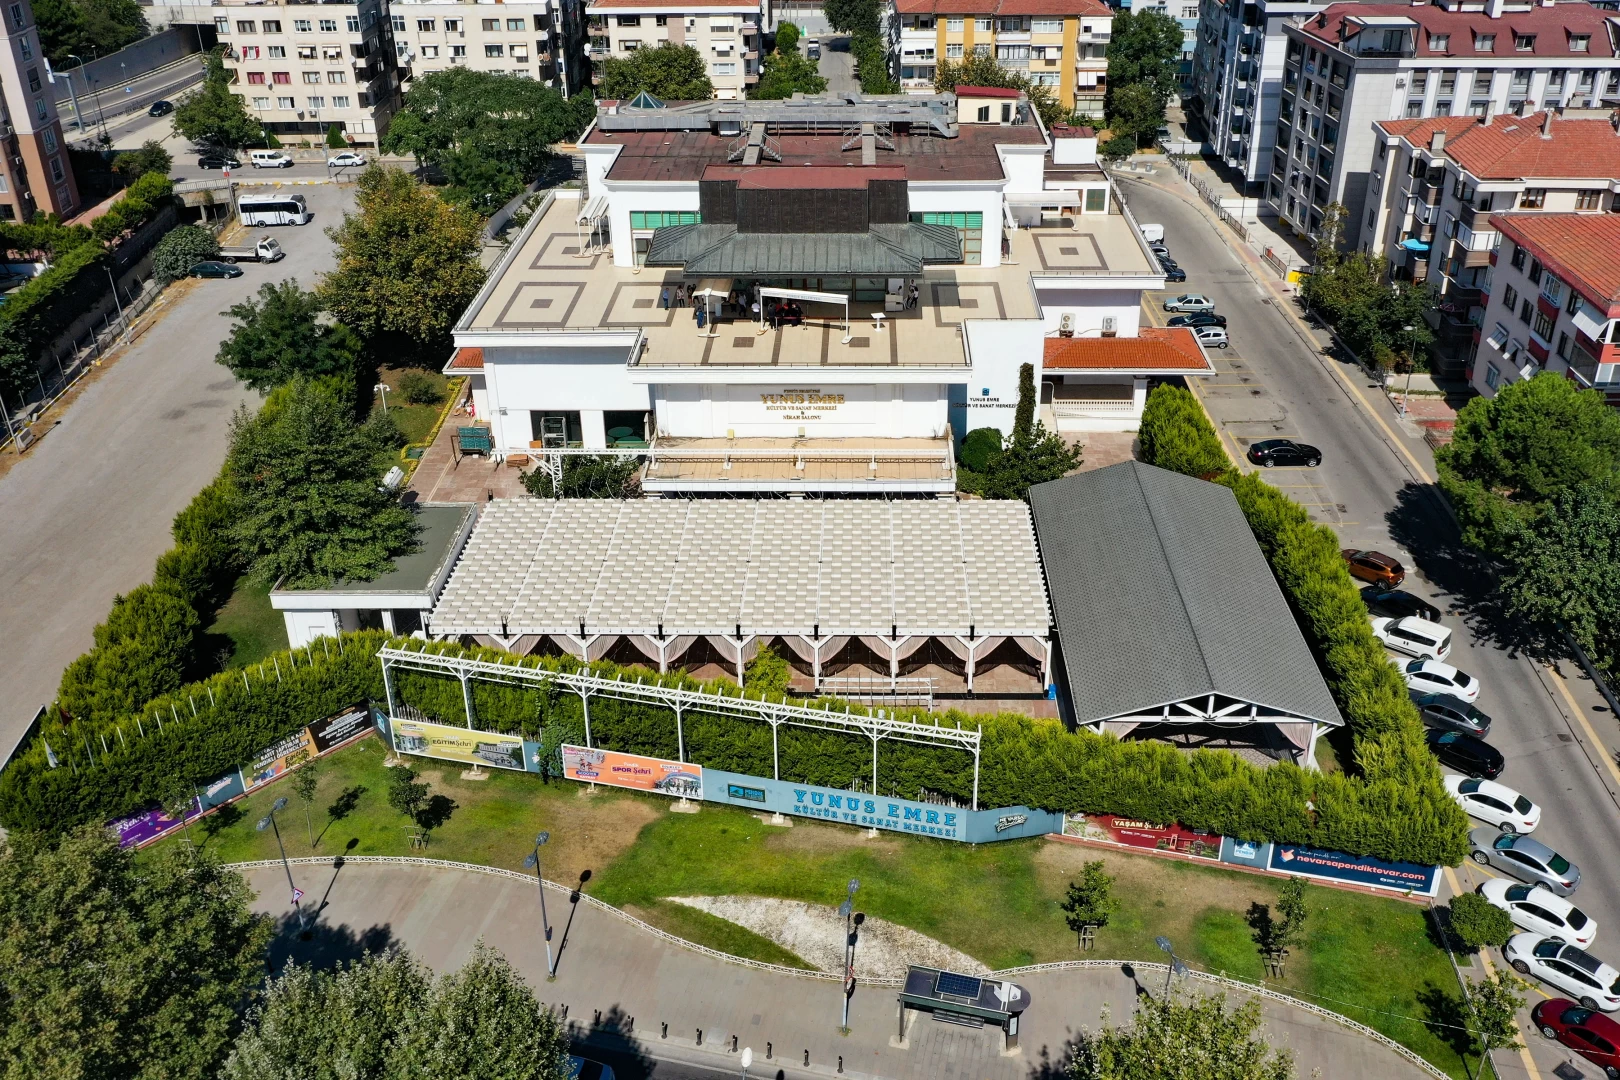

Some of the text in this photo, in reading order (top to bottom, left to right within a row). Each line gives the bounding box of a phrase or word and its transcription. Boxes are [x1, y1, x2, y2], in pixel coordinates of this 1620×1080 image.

[760, 394, 845, 404] YUNUS EMRE
[632, 767, 652, 775] Şehri
[793, 788, 957, 827] YUNUS EMRE
[793, 804, 957, 838] KÜLTÜR VE SANAT MERKEZİ
[1114, 820, 1144, 828] YAŞAM
[1296, 855, 1426, 881] nevarsapendiktevar.com
